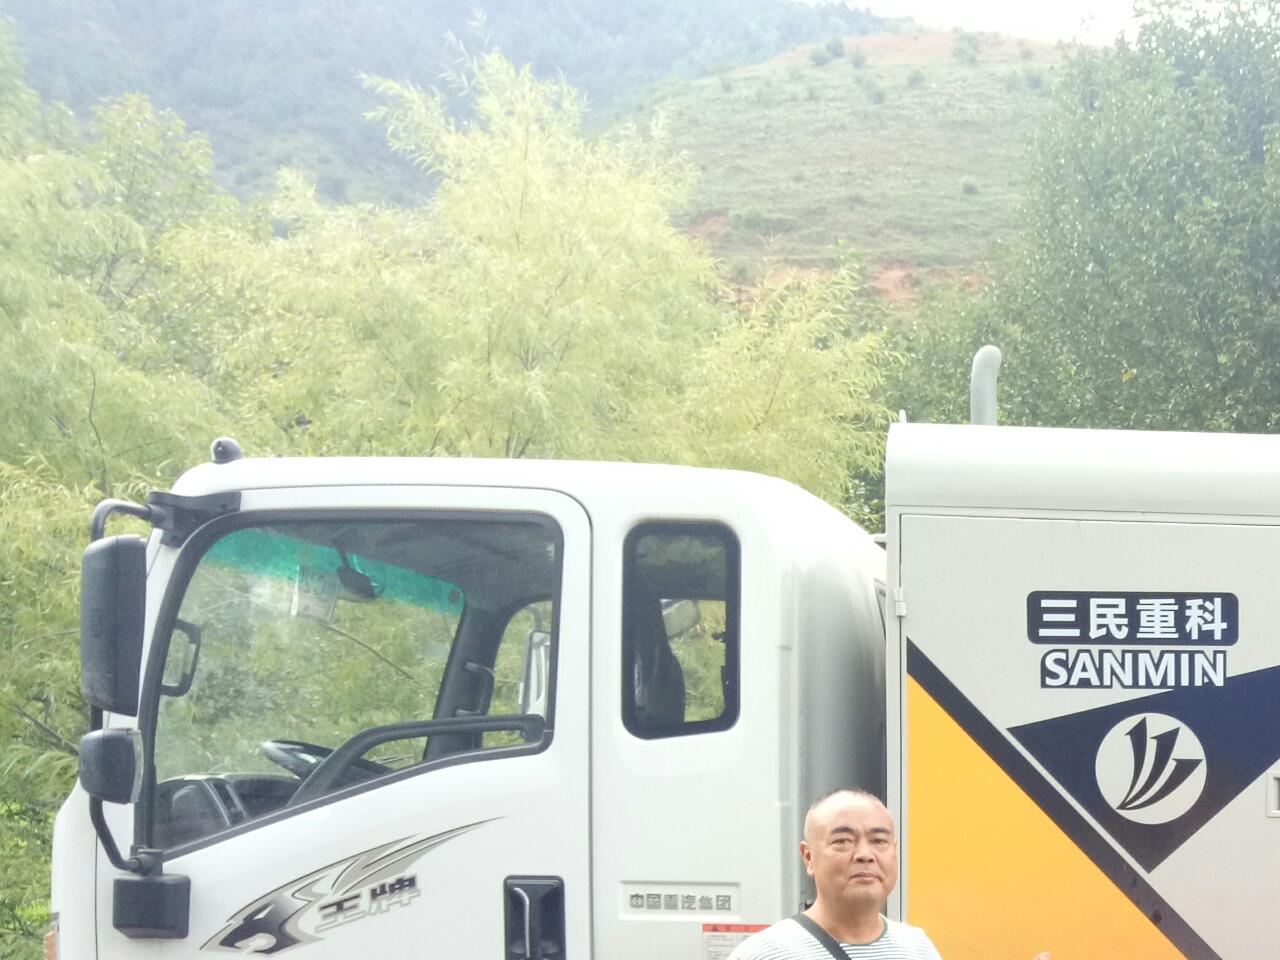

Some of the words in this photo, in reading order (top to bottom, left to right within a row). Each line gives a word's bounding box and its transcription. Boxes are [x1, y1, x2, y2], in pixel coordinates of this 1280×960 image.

[1038, 597, 1228, 640] 三民重科
[1044, 651, 1225, 687] SANMIN
[315, 874, 421, 933] 王牌
[629, 893, 732, 911] 中国重汽集团
